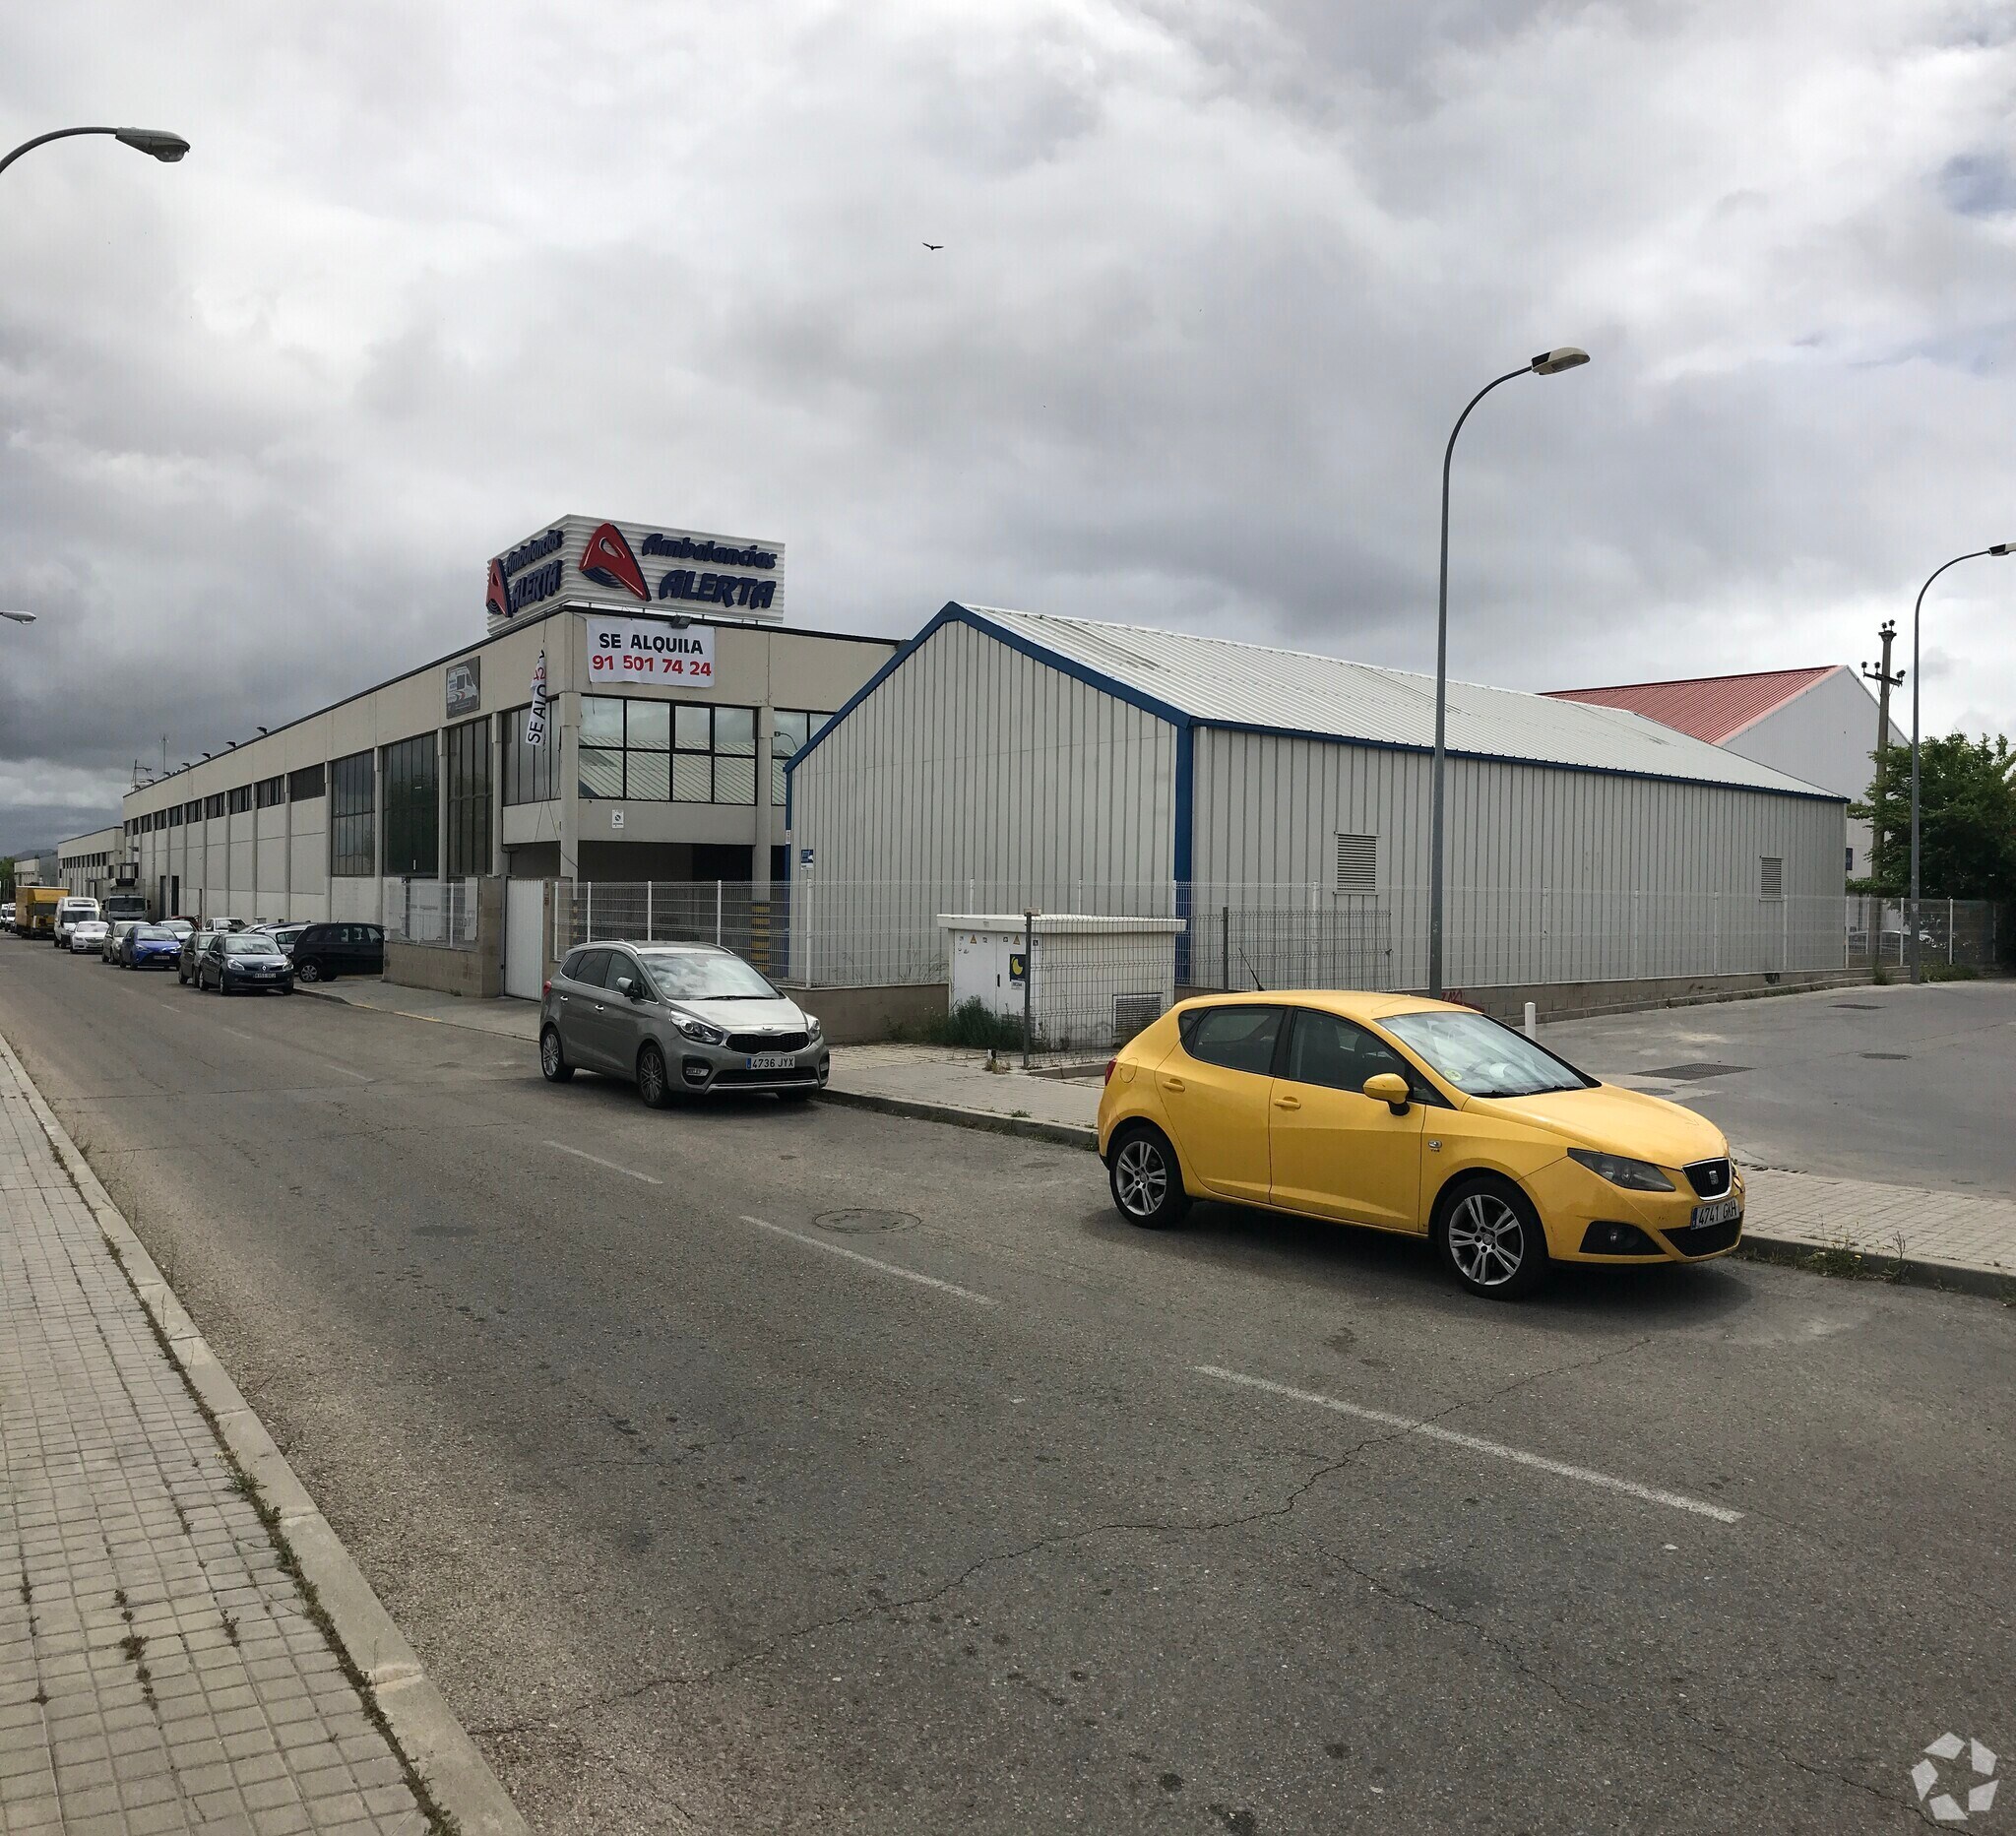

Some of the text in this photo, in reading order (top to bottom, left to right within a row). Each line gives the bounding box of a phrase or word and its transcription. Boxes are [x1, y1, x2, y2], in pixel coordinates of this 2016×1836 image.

[505, 530, 564, 577] Ambulancias
[642, 533, 778, 570] Ambulancias
[511, 559, 563, 613] ALERTA
[659, 569, 777, 610] ALERTA
[598, 633, 704, 655] SE ALQUILA
[592, 654, 712, 677] 91 501 74 24
[528, 721, 544, 743] SE
[752, 1057, 793, 1068] 4736 JYX
[1699, 1204, 1719, 1225] 4741
